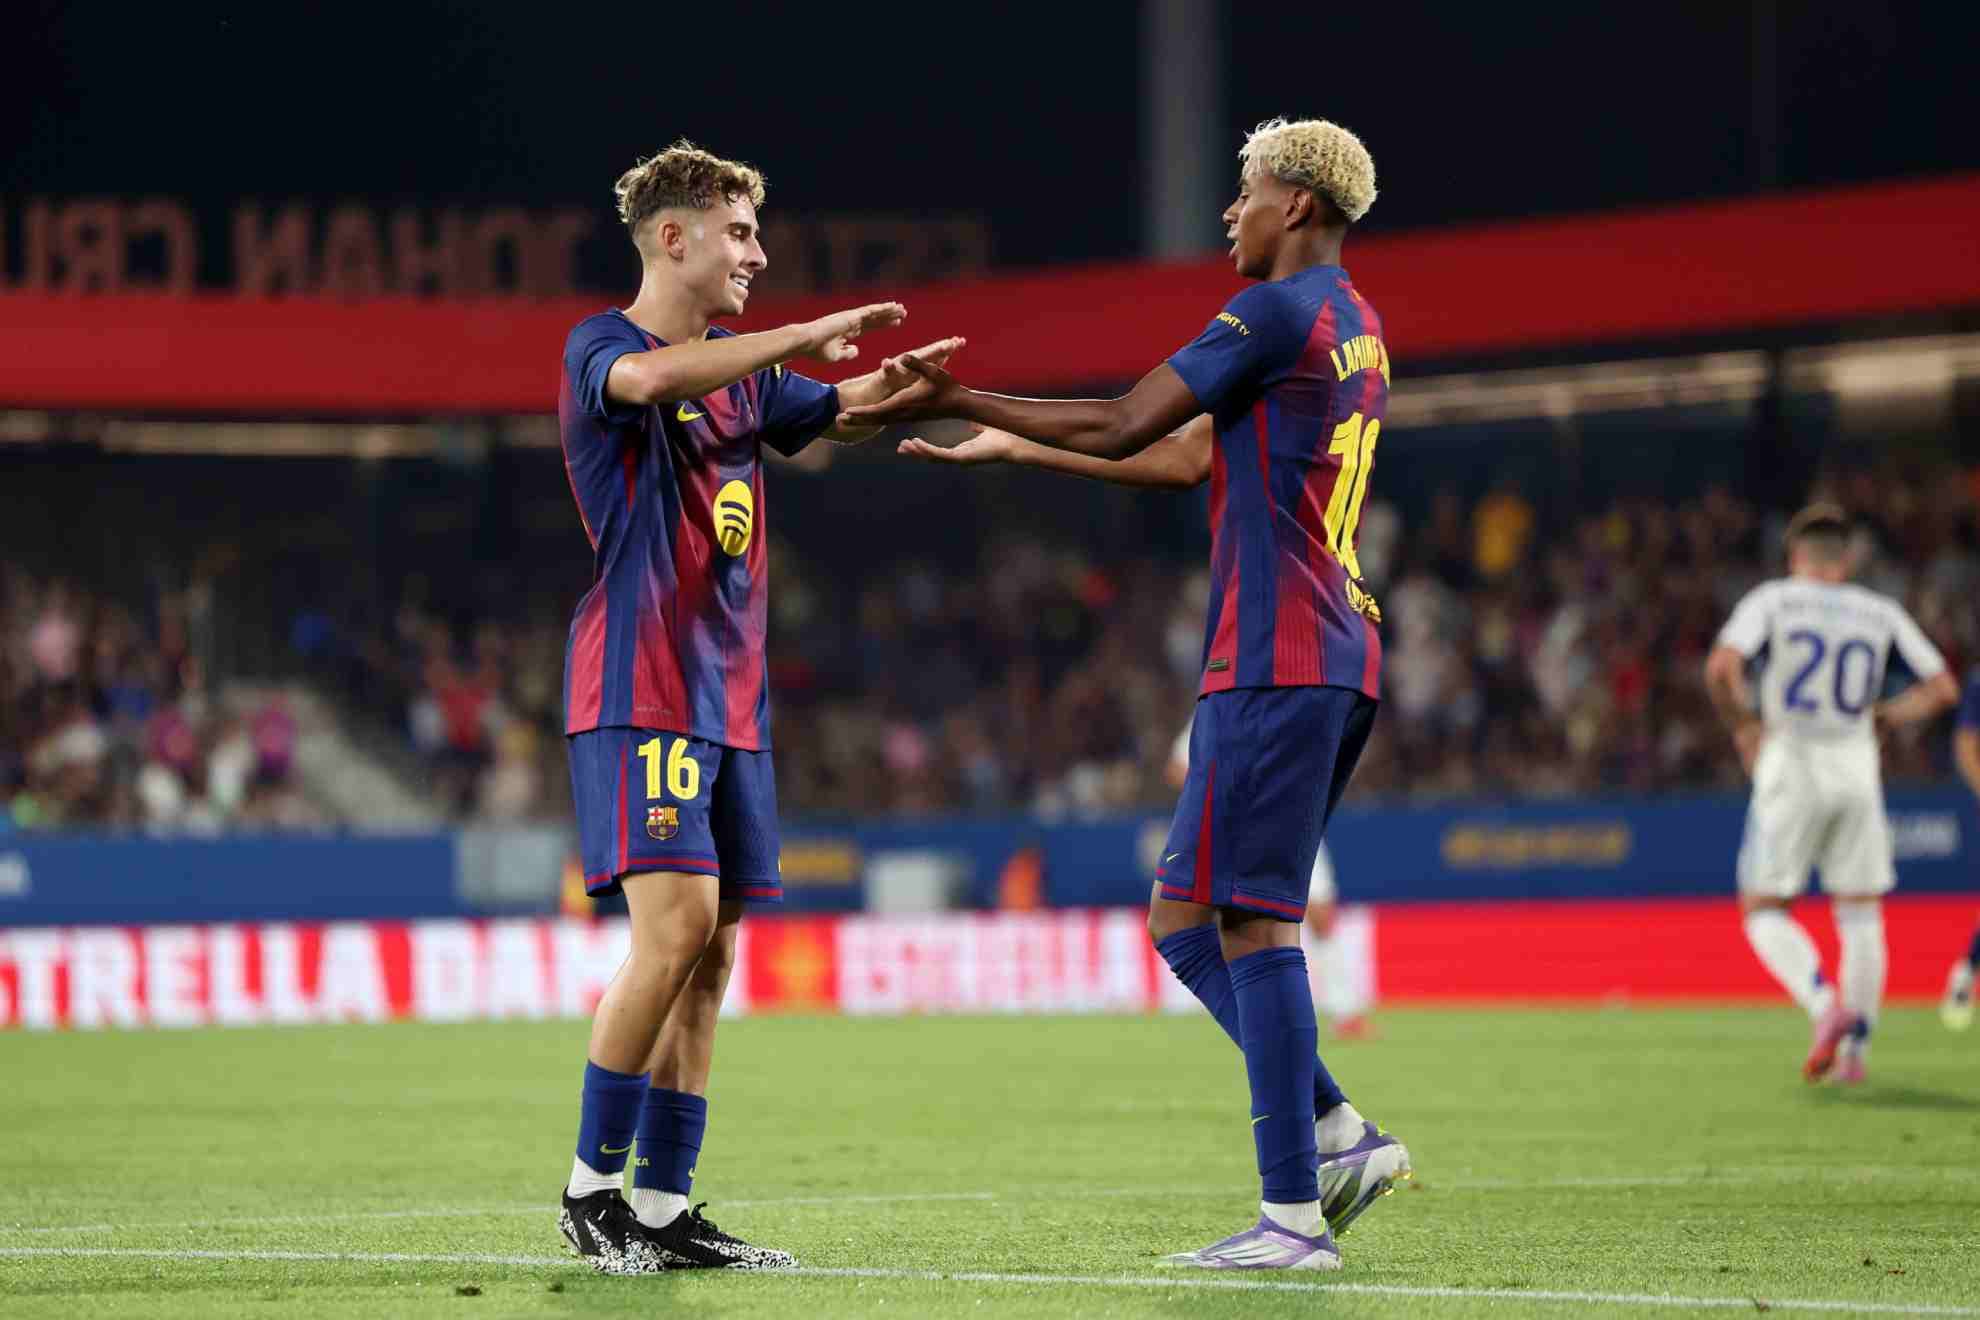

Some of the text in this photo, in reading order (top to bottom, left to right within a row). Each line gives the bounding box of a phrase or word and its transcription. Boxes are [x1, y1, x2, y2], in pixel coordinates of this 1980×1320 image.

[1785, 629, 1875, 715] 20
[637, 736, 700, 800] 16
[412, 918, 742, 1019] DAM
